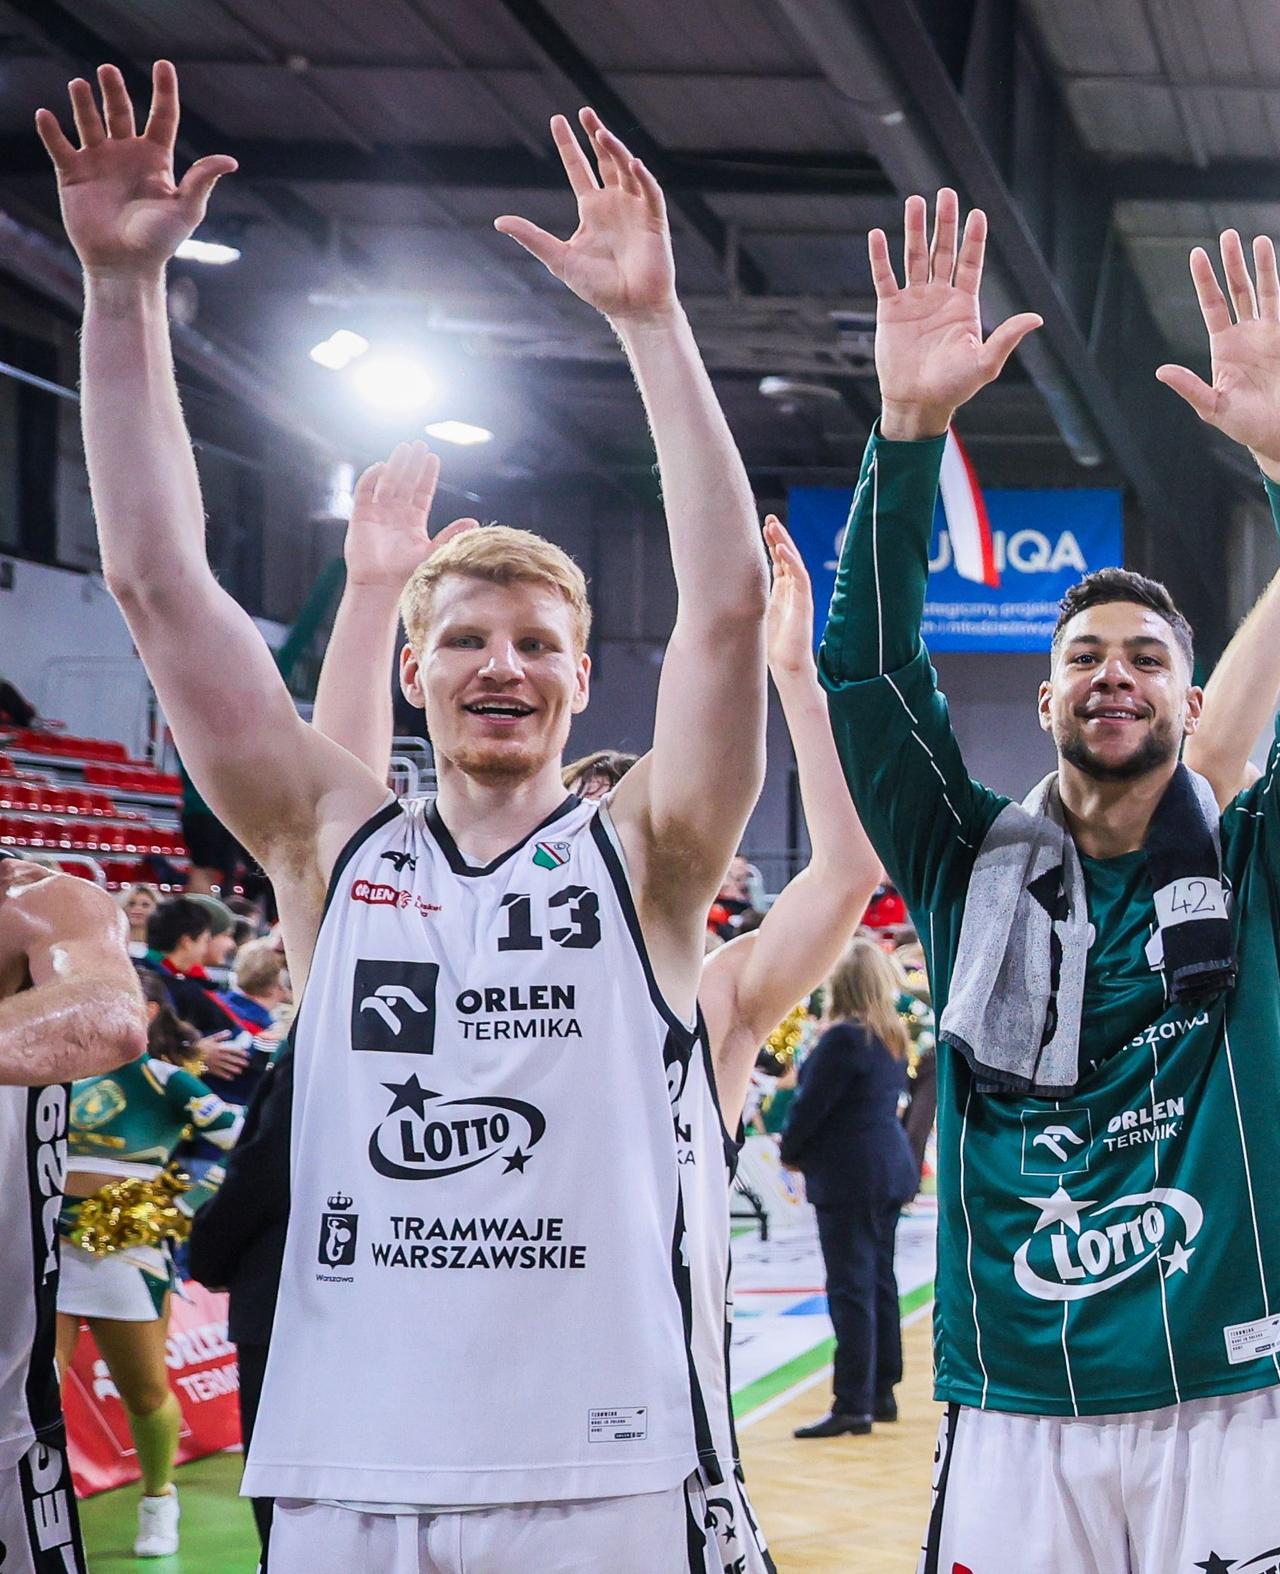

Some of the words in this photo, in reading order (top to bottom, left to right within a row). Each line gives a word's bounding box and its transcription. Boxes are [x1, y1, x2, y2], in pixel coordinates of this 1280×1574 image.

[1171, 880, 1216, 914] 42
[498, 885, 601, 952] 13
[456, 984, 576, 1014] ORLEN
[458, 1018, 583, 1040] TERMIKA
[1107, 1097, 1185, 1133] ORLEN
[400, 1112, 510, 1162] LOTTO
[1103, 1121, 1184, 1152] TERMIK
[390, 1216, 564, 1241] TRAMWAJE
[1051, 1207, 1166, 1280] LOTTO
[371, 1242, 587, 1270] WARSZAWSKIE
